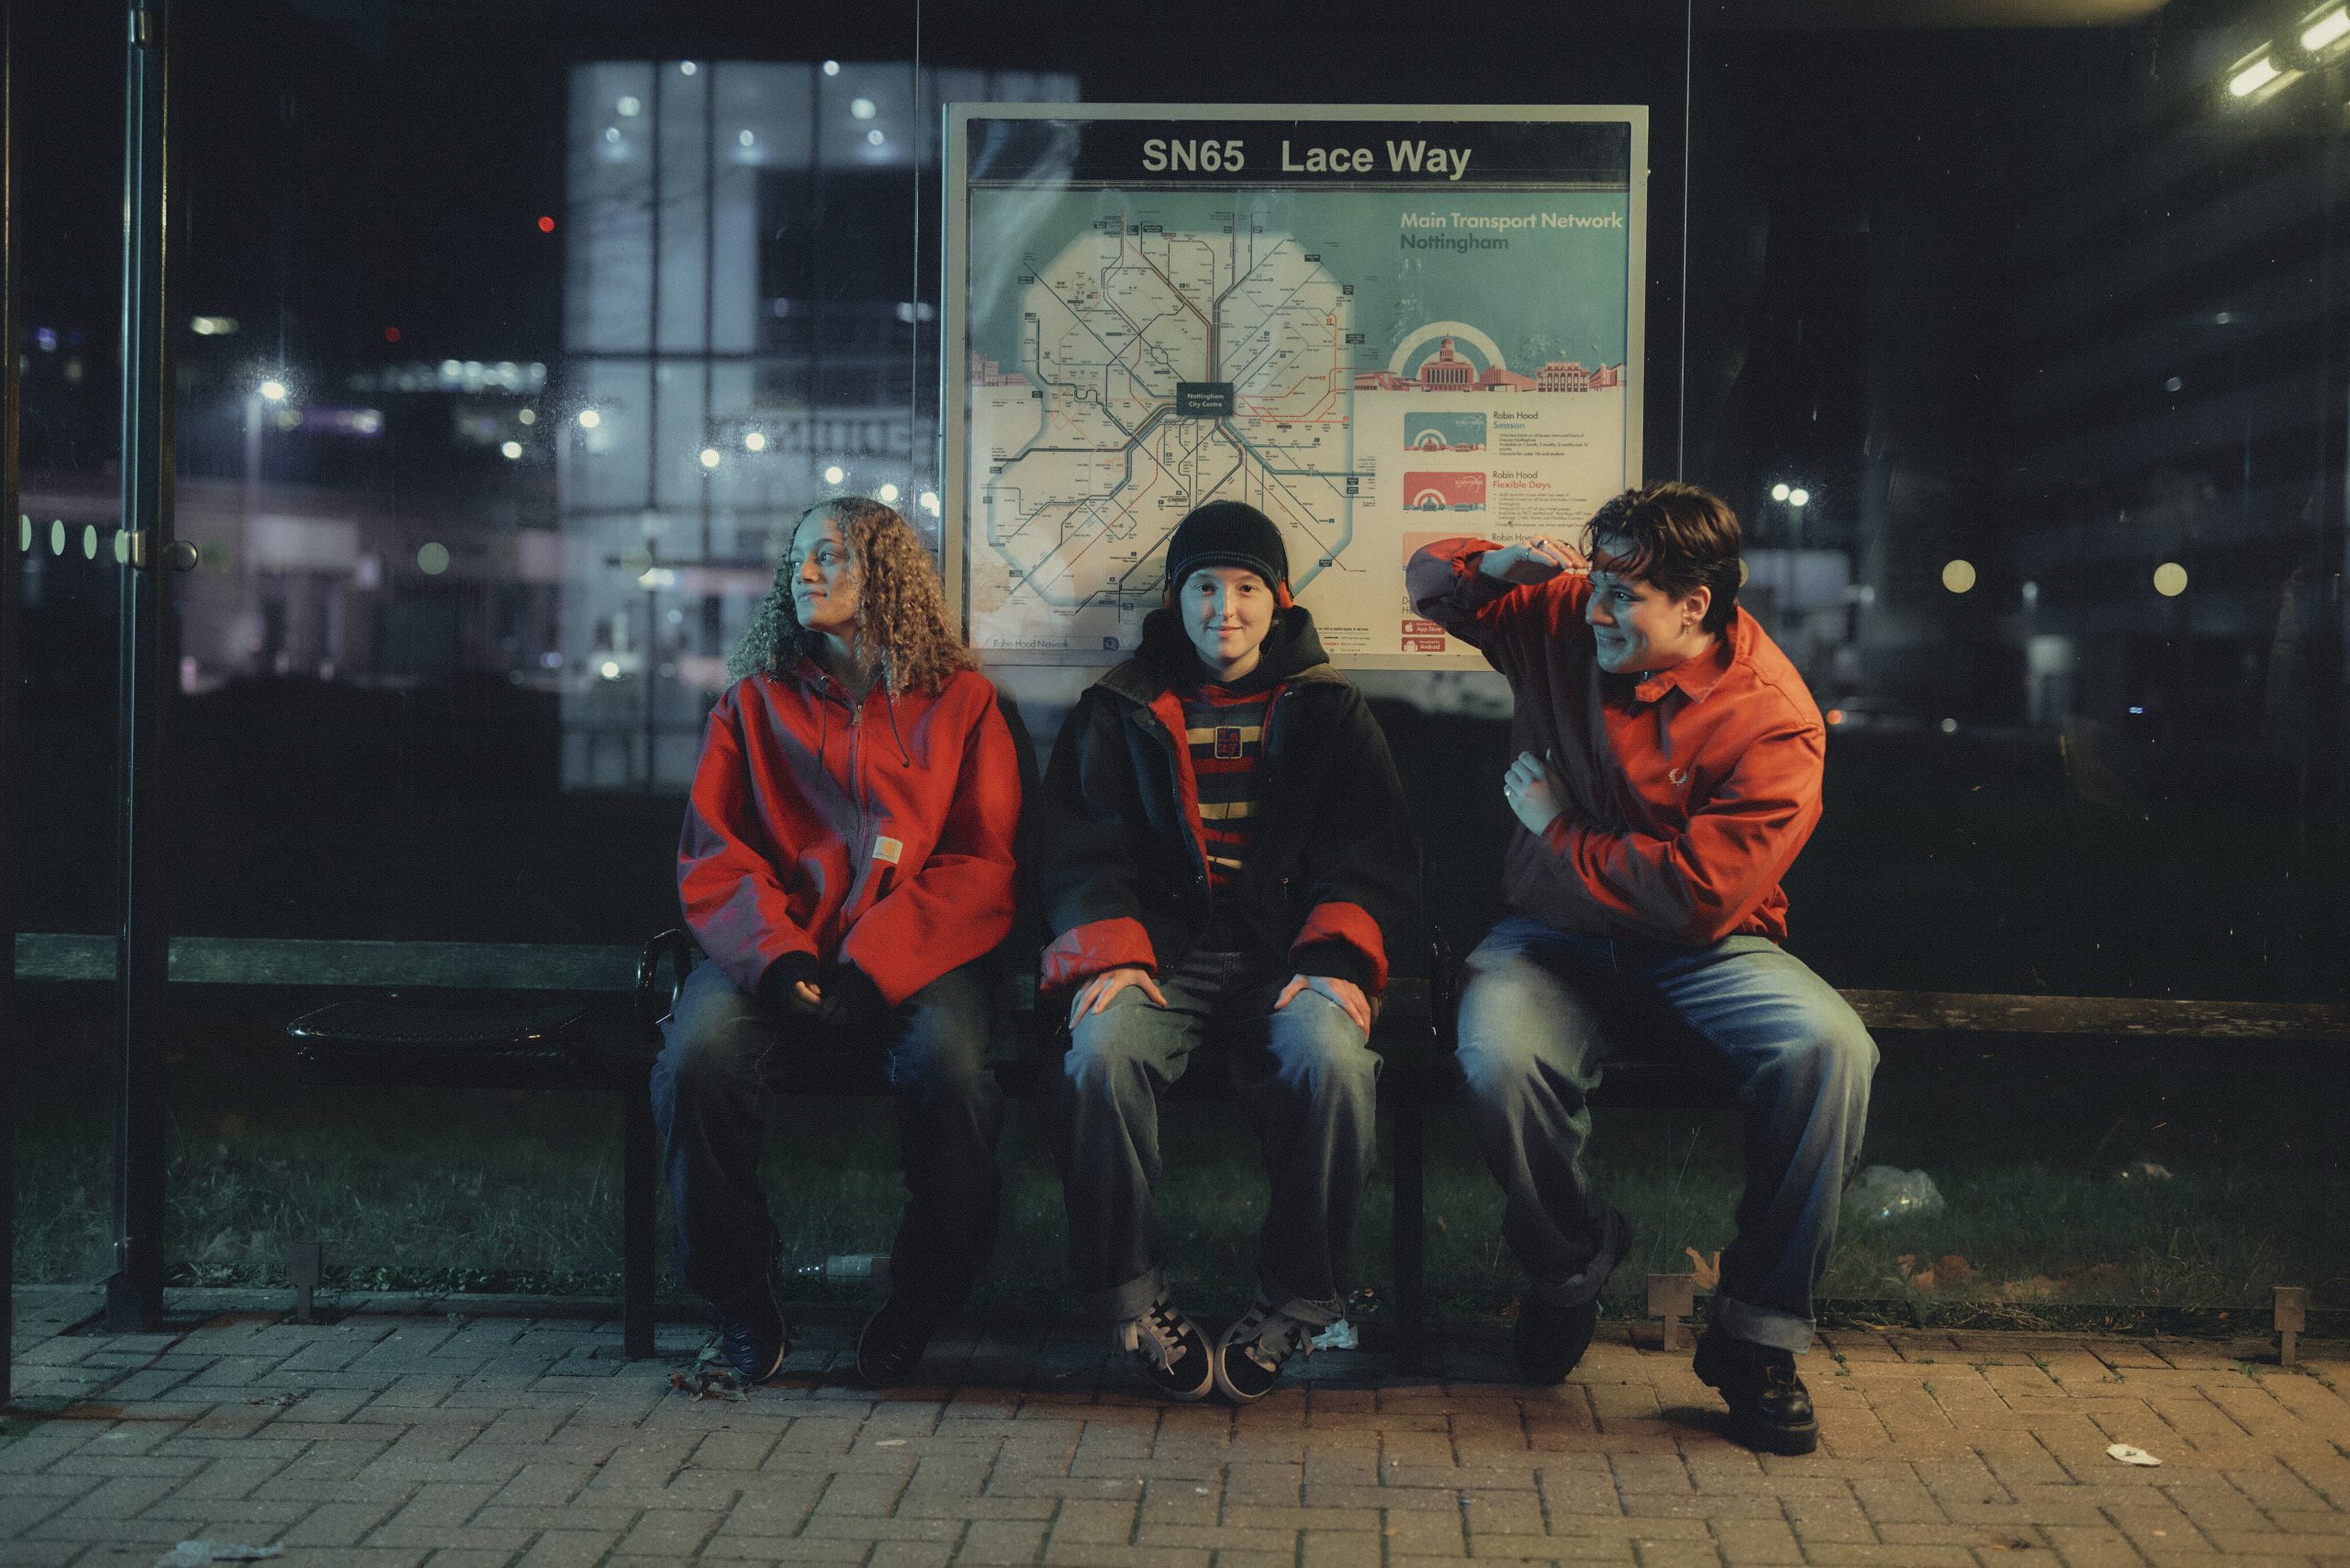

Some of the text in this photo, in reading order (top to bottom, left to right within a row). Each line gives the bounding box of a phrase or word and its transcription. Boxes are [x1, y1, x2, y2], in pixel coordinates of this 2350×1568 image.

[1142, 139, 1472, 181] SN65 Lace Way
[1400, 211, 1623, 233] Main Transport Network
[1400, 232, 1508, 254] Nottingham
[1493, 410, 1539, 420] Robin Hood
[1493, 420, 1526, 430] Season
[1493, 470, 1539, 479] Robin Hood
[1493, 480, 1527, 489] Flexible
[1528, 480, 1551, 490] Days
[1492, 532, 1513, 542] Robin
[993, 639, 1069, 647] Robin Hood Network
